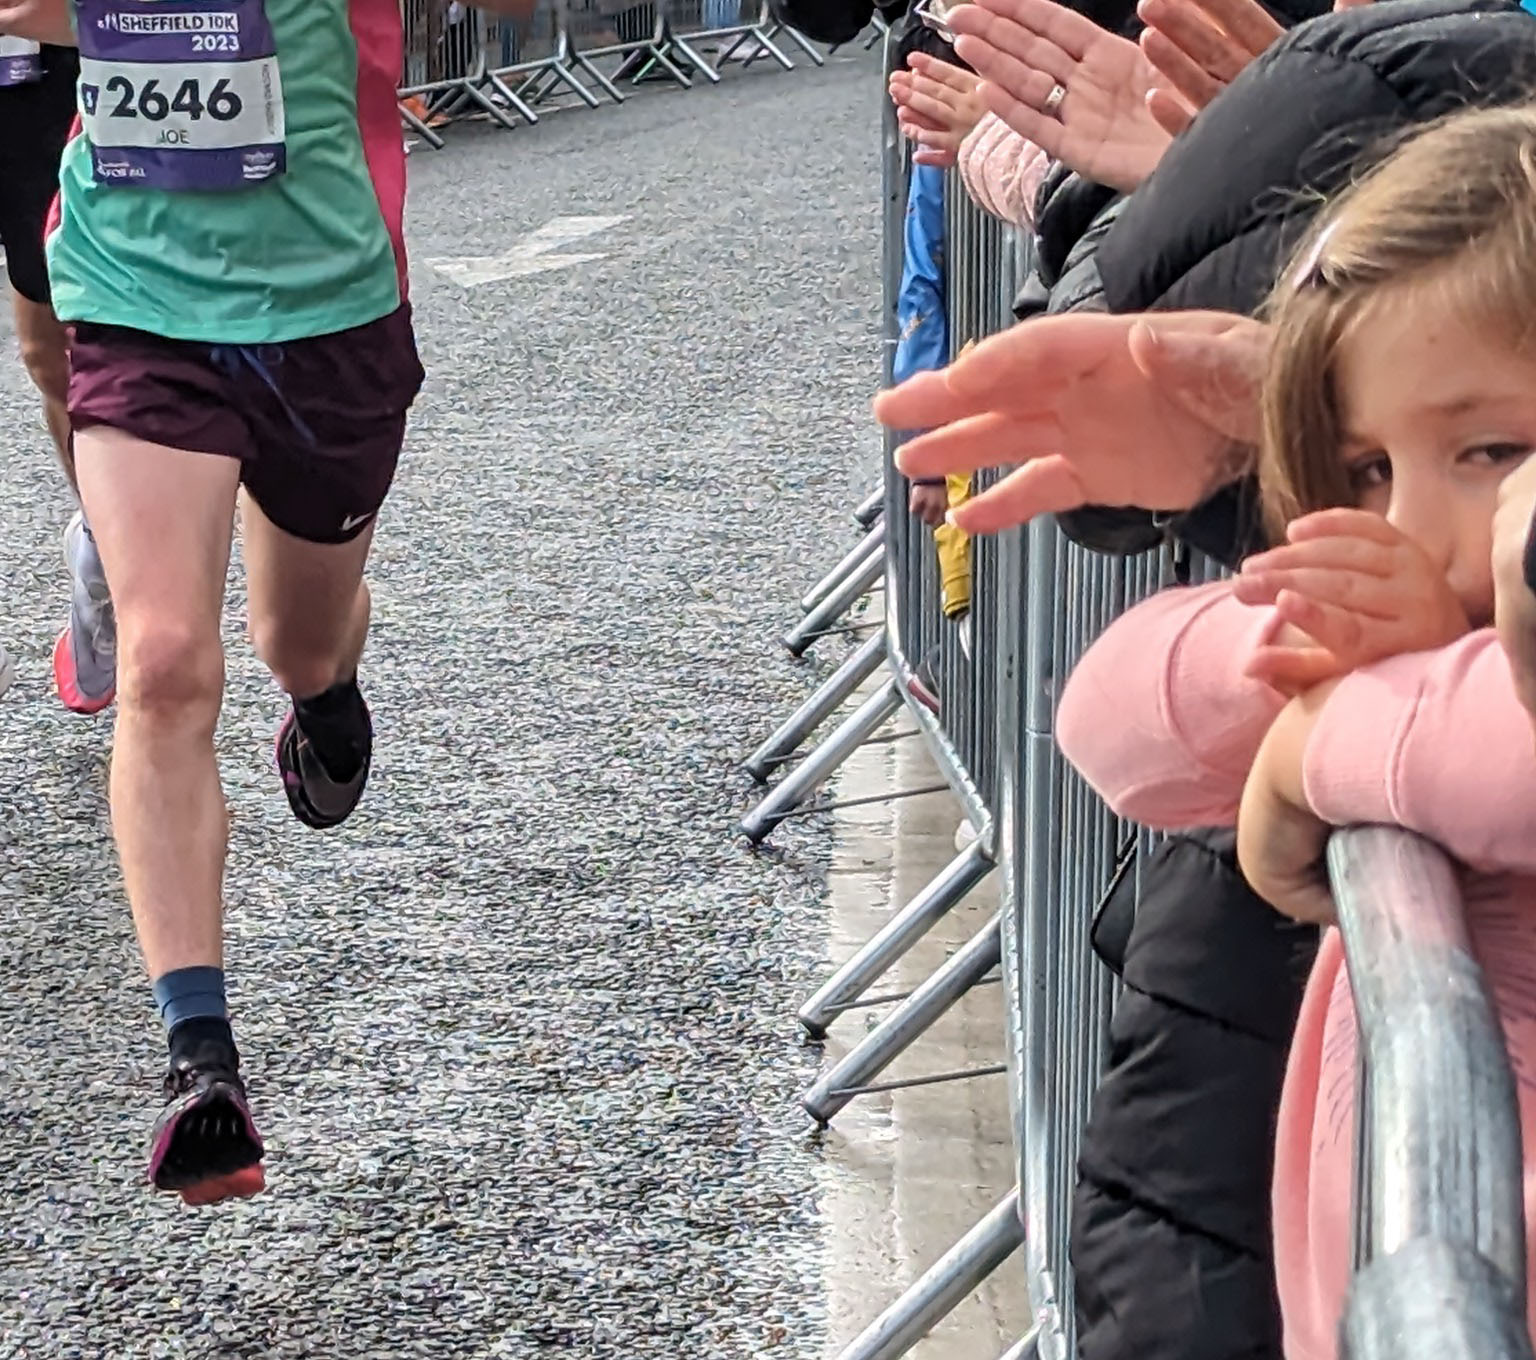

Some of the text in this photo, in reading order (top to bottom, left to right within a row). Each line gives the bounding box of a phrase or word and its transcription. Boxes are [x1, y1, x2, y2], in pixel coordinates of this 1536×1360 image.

[121, 16, 236, 31] SHEFFIELD 10K
[191, 35, 240, 51] 2023
[106, 76, 242, 121] 2646
[158, 130, 189, 144] JOE
